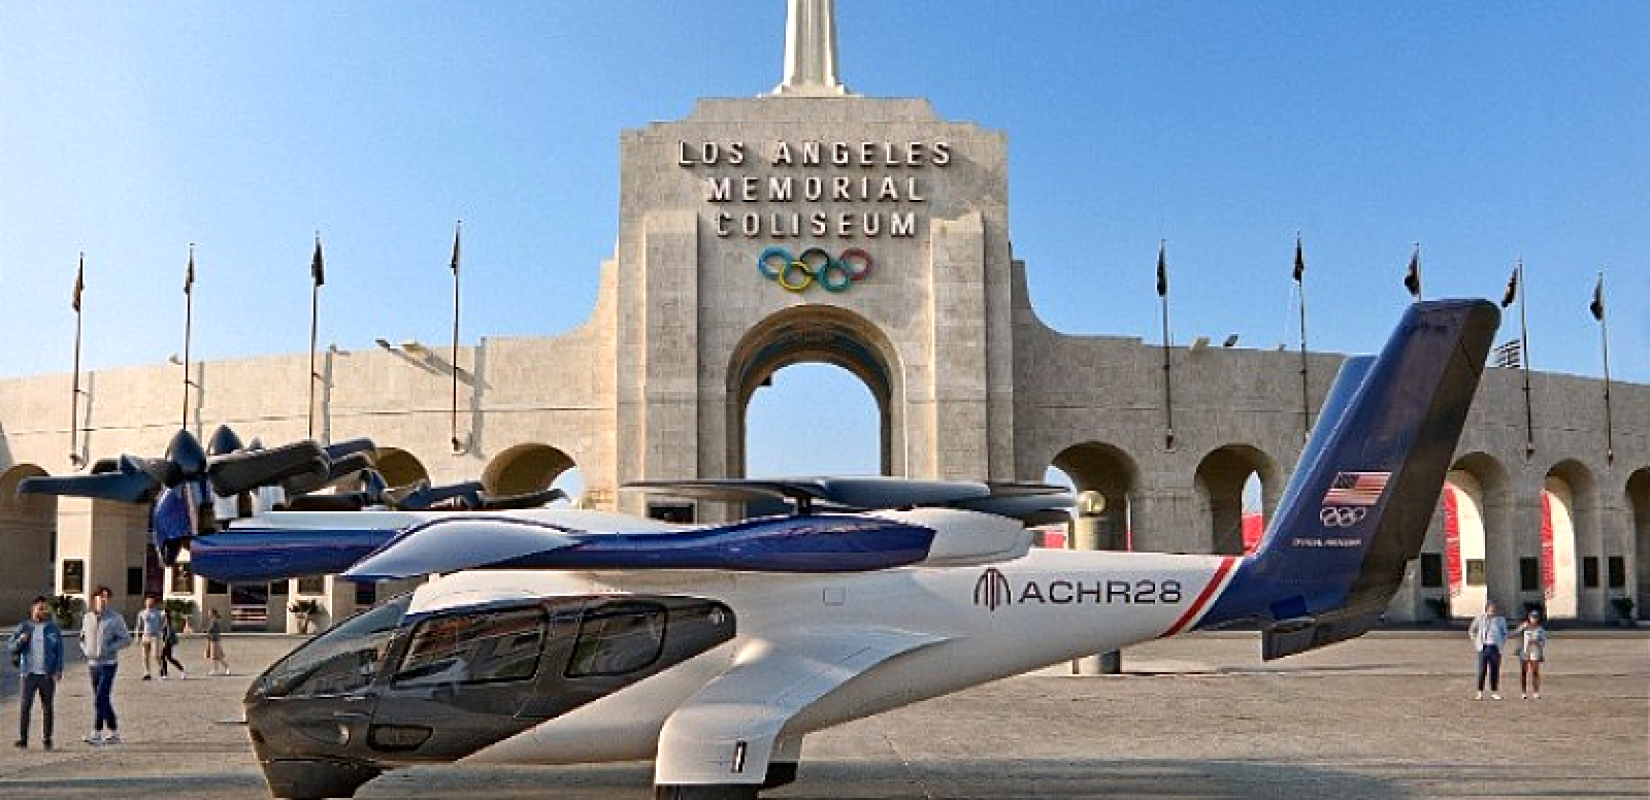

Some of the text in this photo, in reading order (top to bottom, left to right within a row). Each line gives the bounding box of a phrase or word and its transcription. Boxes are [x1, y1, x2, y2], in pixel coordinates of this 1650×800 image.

[678, 140, 951, 167] LOS ANGELES
[707, 175, 924, 202] MEMORIAL
[716, 210, 916, 237] COLISEUM
[1018, 579, 1183, 605] ACHR28
